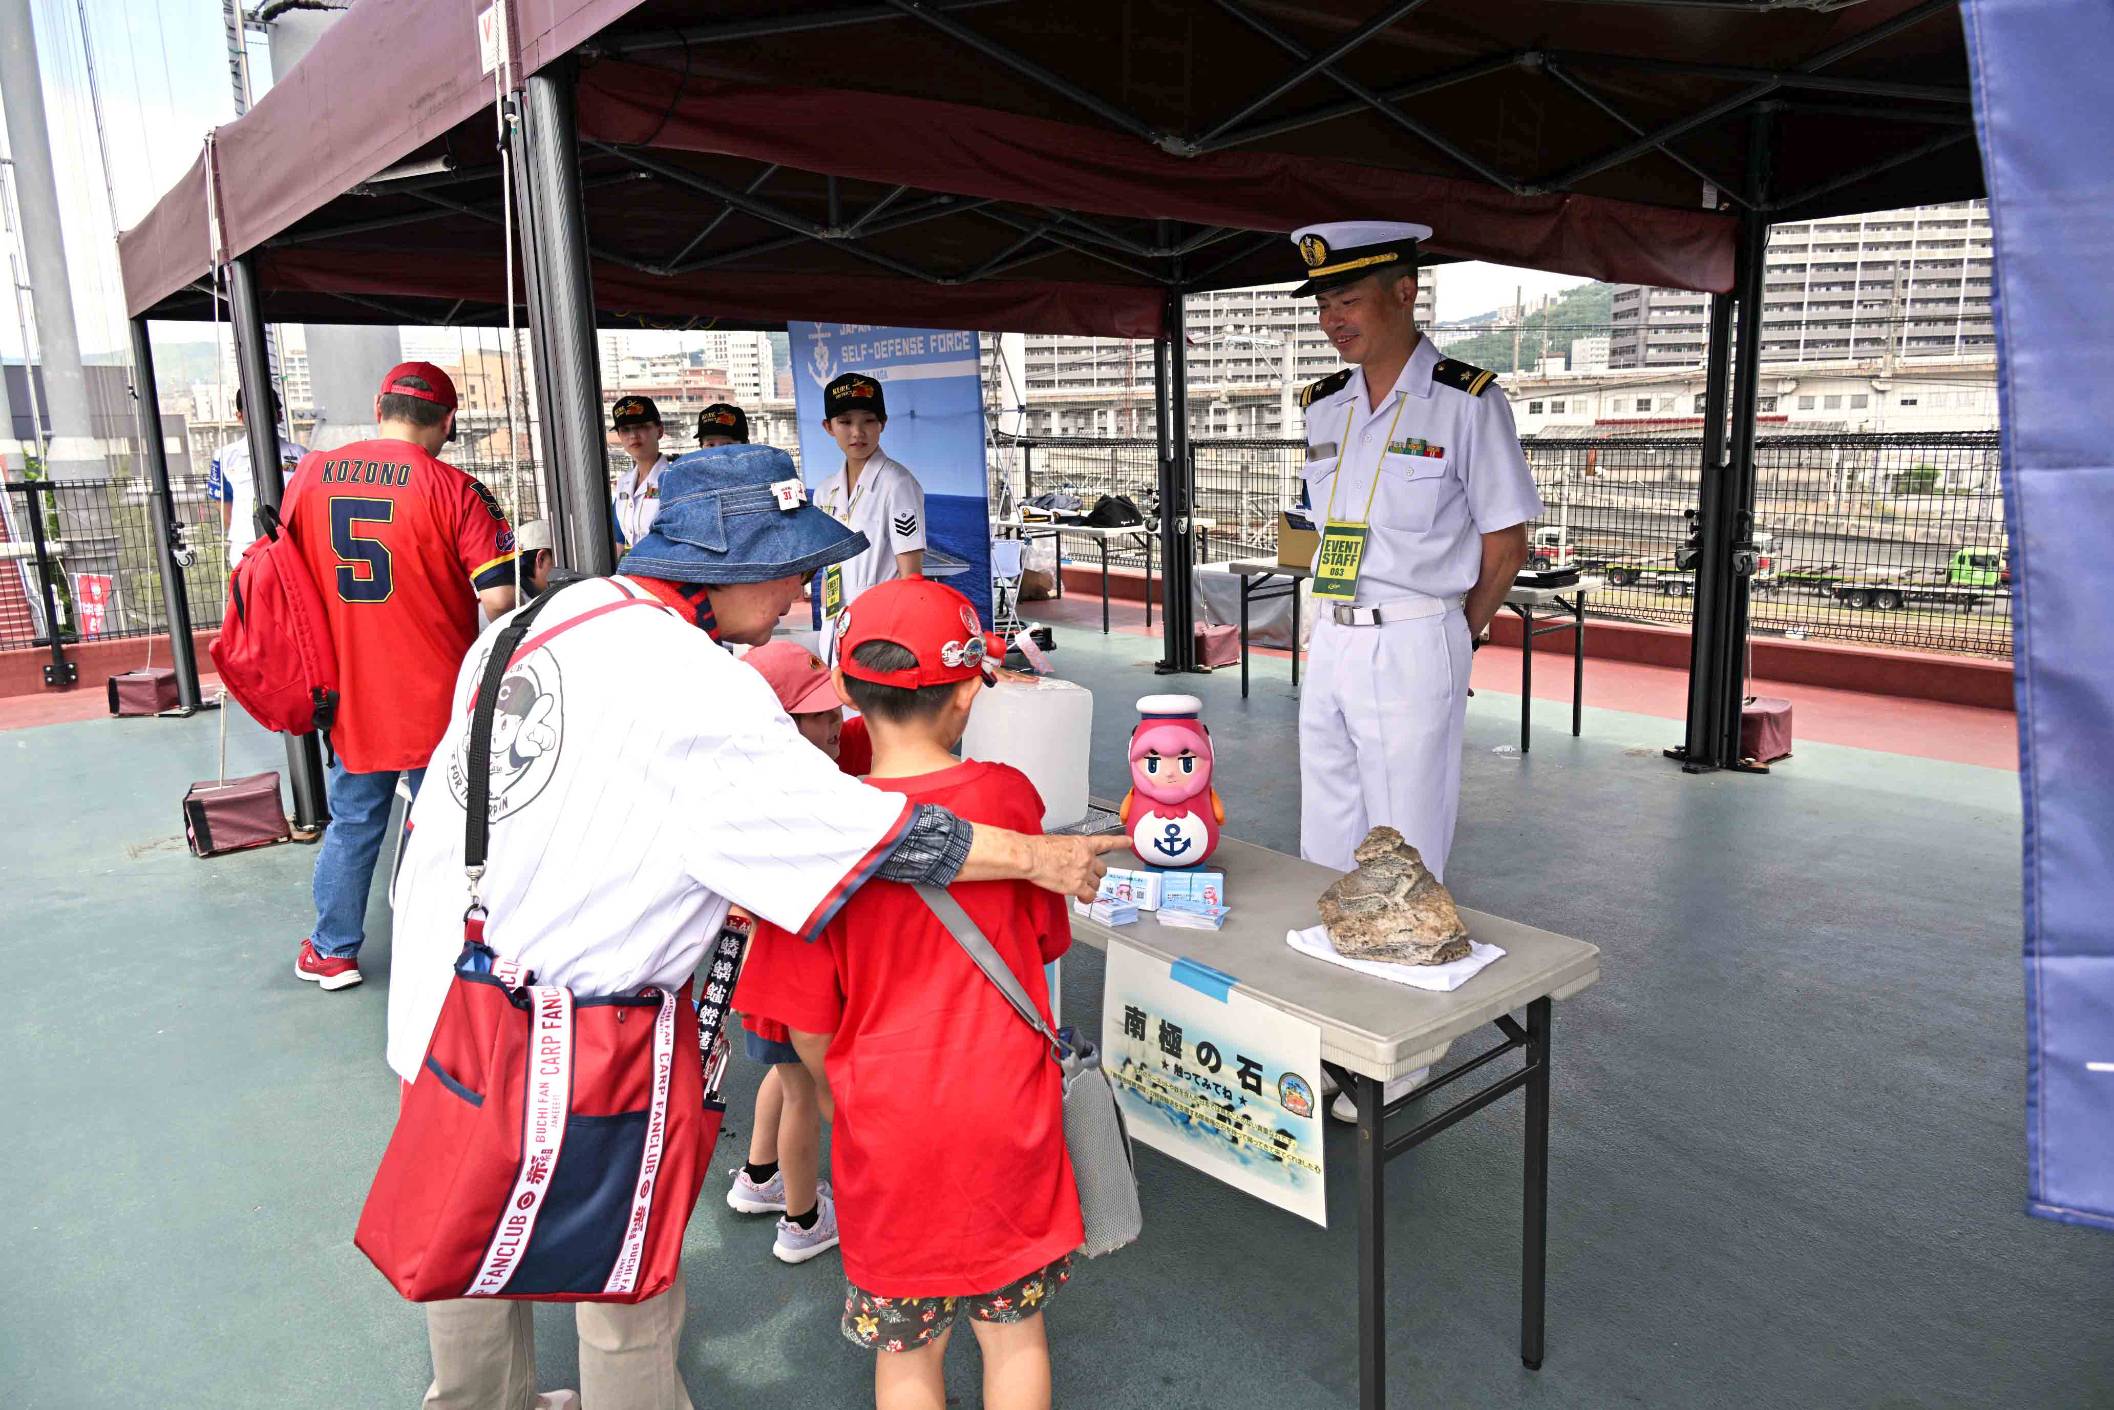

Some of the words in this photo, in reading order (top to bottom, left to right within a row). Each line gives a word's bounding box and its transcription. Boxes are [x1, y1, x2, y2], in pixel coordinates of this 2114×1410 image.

[841, 336, 924, 364] SELF-DEFENSE
[930, 331, 971, 353] FORCE
[321, 460, 412, 487] KOZONO
[329, 496, 394, 603] 5
[1322, 552, 1358, 566] STAFF
[1324, 540, 1360, 554] EVENT
[541, 986, 562, 1030] FANC
[539, 1035, 561, 1075] CARP
[1124, 1004, 1264, 1097] 南極の石
[537, 1081, 550, 1105] FAN
[658, 1052, 670, 1095] CARP
[1173, 1063, 1233, 1101] 触ってみてね
[643, 1100, 664, 1175] FANCLUB
[479, 1214, 527, 1286] FANCLUB
[624, 1242, 640, 1275] BUCHI
